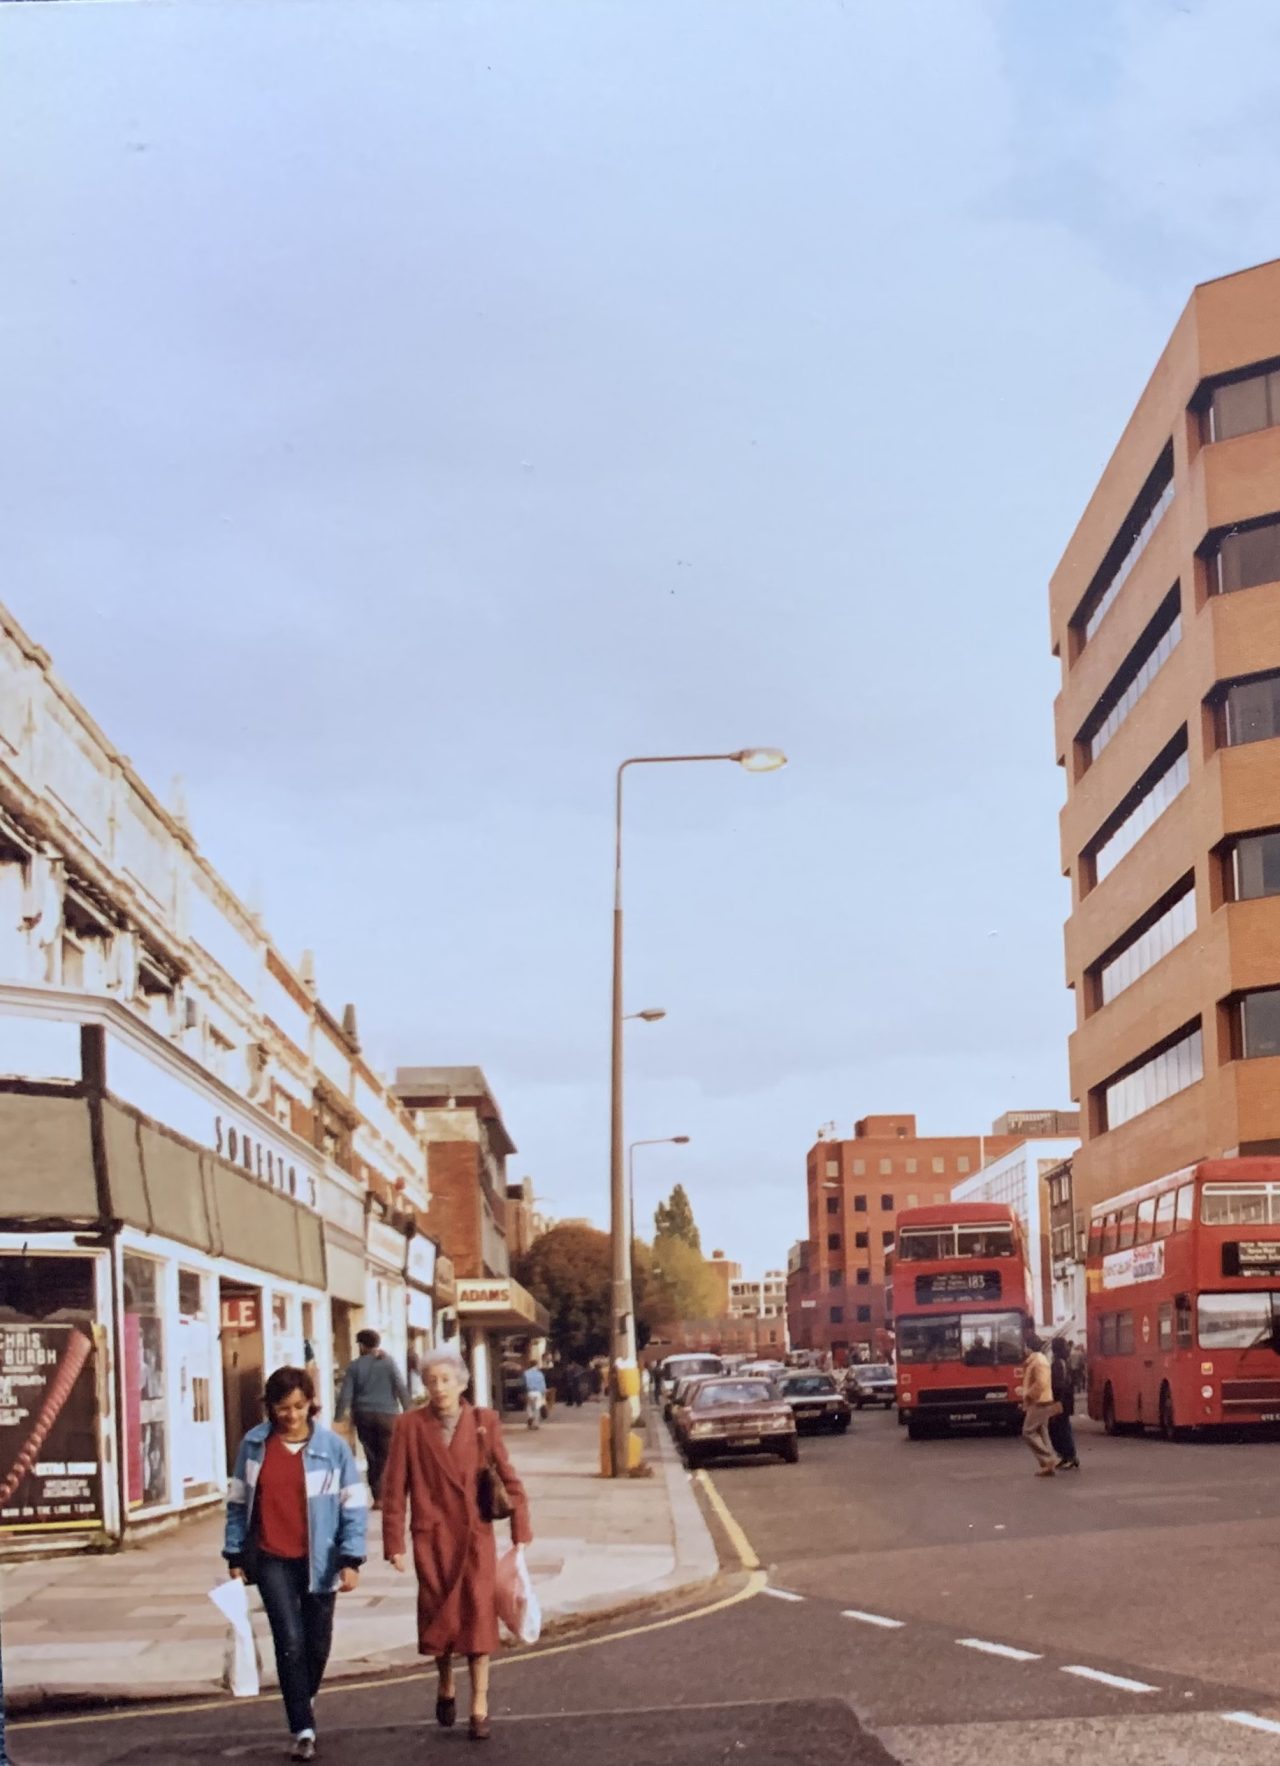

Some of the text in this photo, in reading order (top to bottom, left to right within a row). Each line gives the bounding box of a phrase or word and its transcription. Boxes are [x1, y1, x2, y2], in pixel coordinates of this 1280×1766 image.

[968, 1275, 985, 1289] 183
[460, 1288, 510, 1301] ADAMS
[5, 1349, 57, 1365] BURGH
